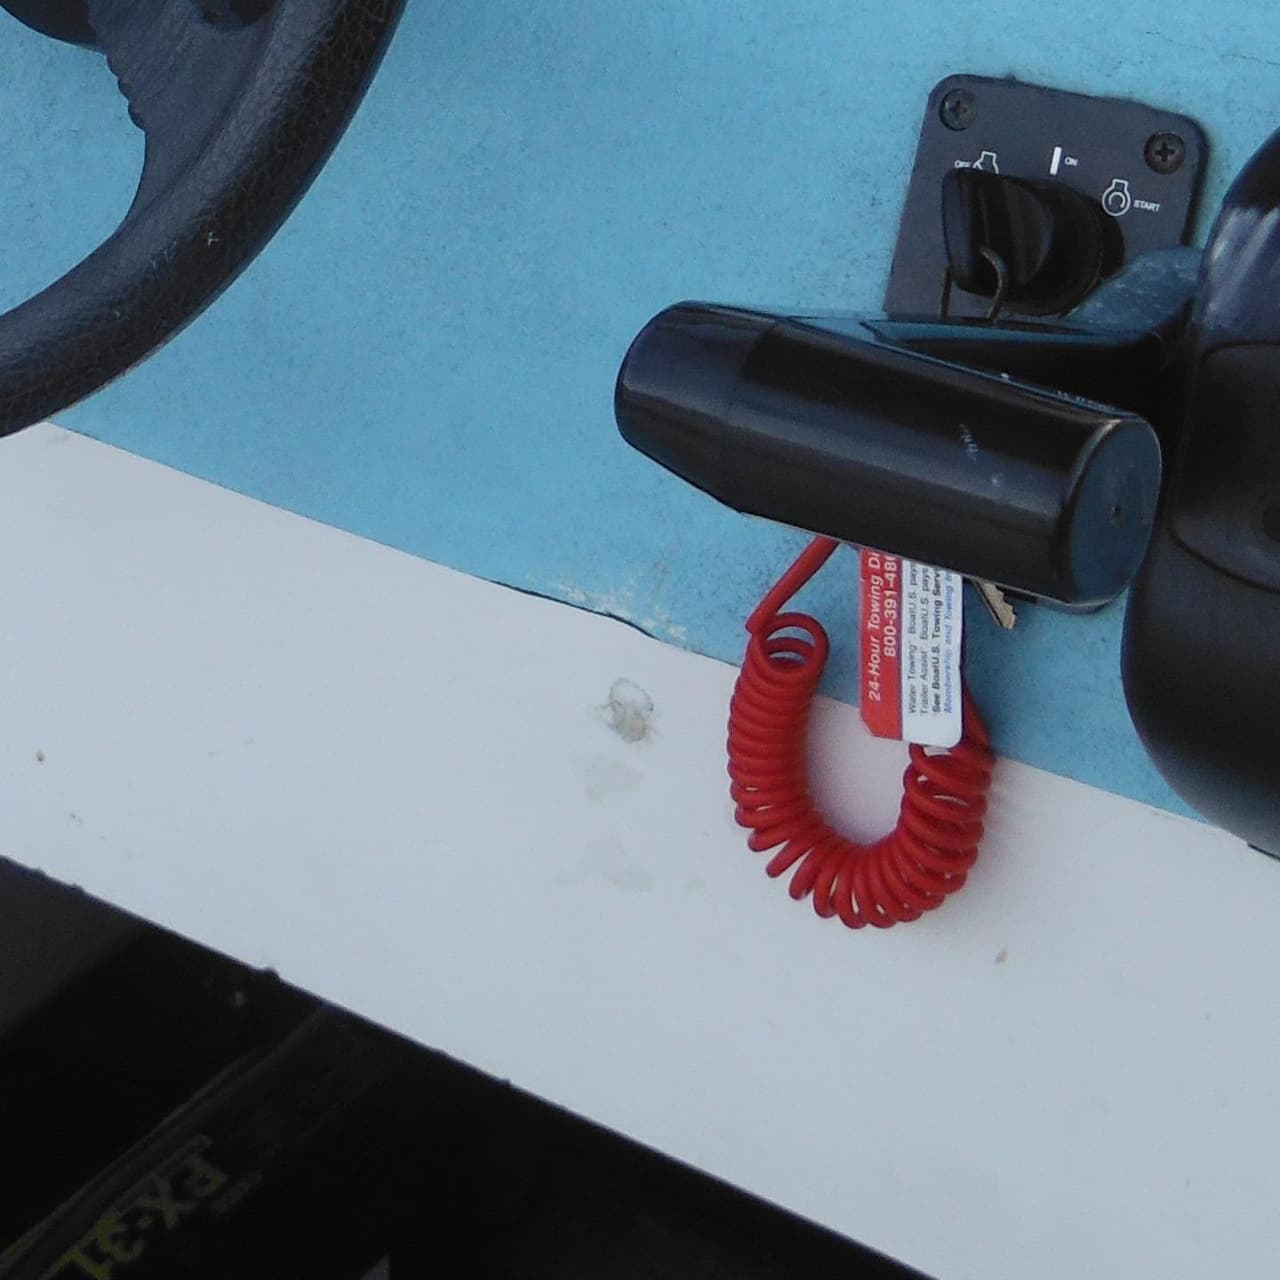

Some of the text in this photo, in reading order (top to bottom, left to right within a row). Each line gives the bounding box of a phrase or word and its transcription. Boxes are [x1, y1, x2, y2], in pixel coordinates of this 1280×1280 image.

[1064, 156, 1079, 167] ON
[1133, 198, 1161, 212] START
[868, 577, 883, 631] Towing
[944, 586, 954, 624] Towing
[932, 601, 944, 638] Towing
[944, 626, 953, 645] and
[868, 637, 881, 701] 24-Hour
[943, 649, 954, 714] Membership
[907, 685, 917, 714] Water
[920, 686, 929, 714] Trailer
[932, 693, 941, 713] See
